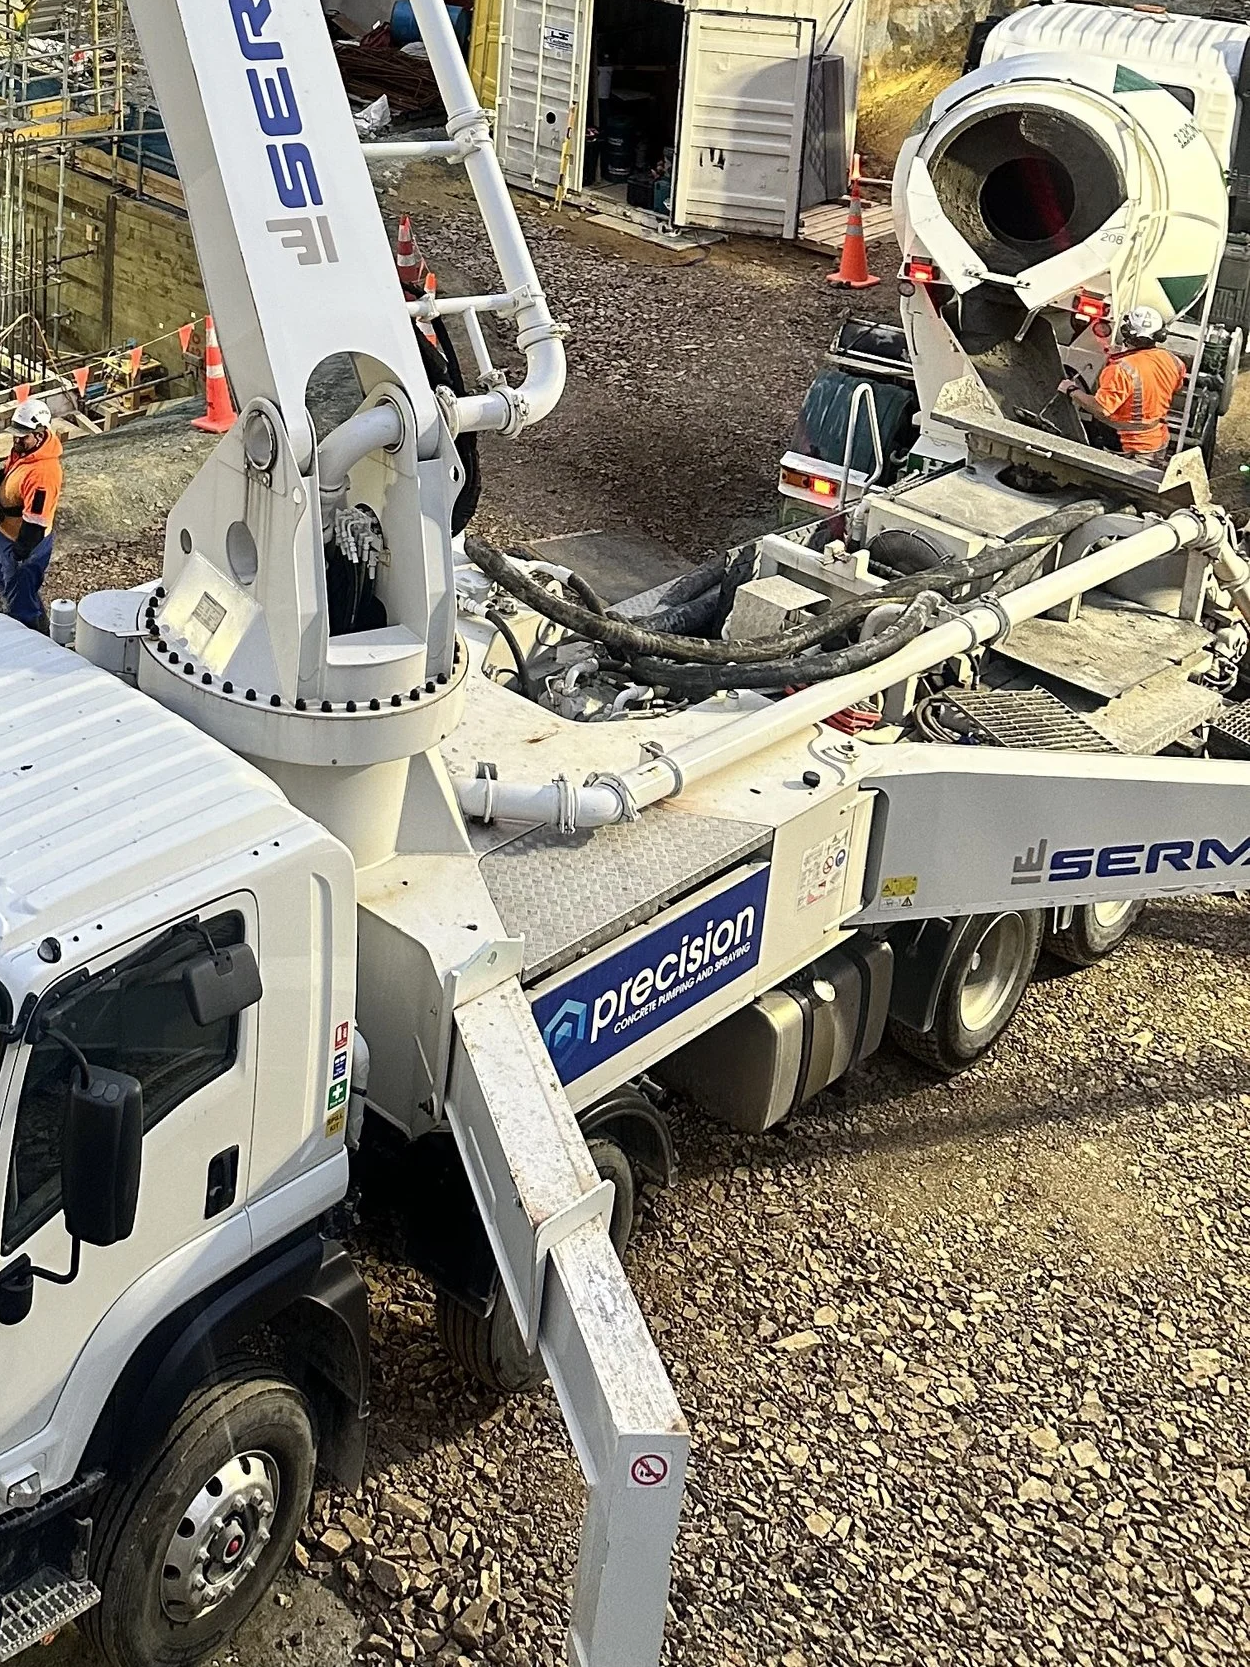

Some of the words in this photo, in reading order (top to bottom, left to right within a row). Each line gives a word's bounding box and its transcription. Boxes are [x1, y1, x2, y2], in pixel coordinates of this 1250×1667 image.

[1100, 232, 1124, 245] 208
[590, 906, 755, 1044] precision
[614, 999, 657, 1034] CONCRETE
[658, 979, 694, 1007] PUMPING
[695, 965, 714, 984] AND
[714, 942, 751, 972] SPRAYING
